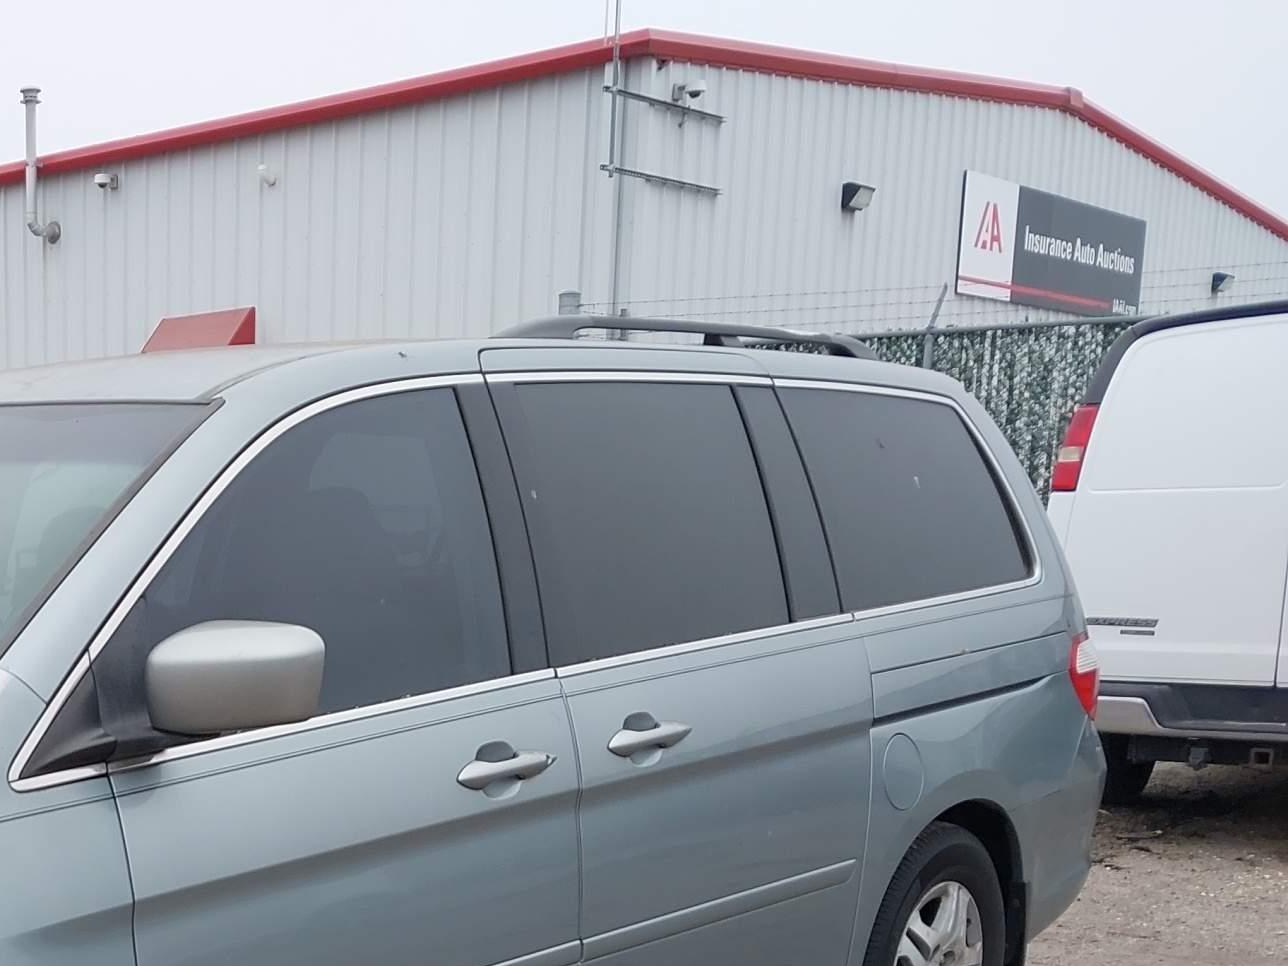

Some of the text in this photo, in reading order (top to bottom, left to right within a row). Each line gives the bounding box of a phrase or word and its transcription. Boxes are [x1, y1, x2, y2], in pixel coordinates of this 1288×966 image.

[1024, 225, 1135, 274] Insurance Auto Auctions
